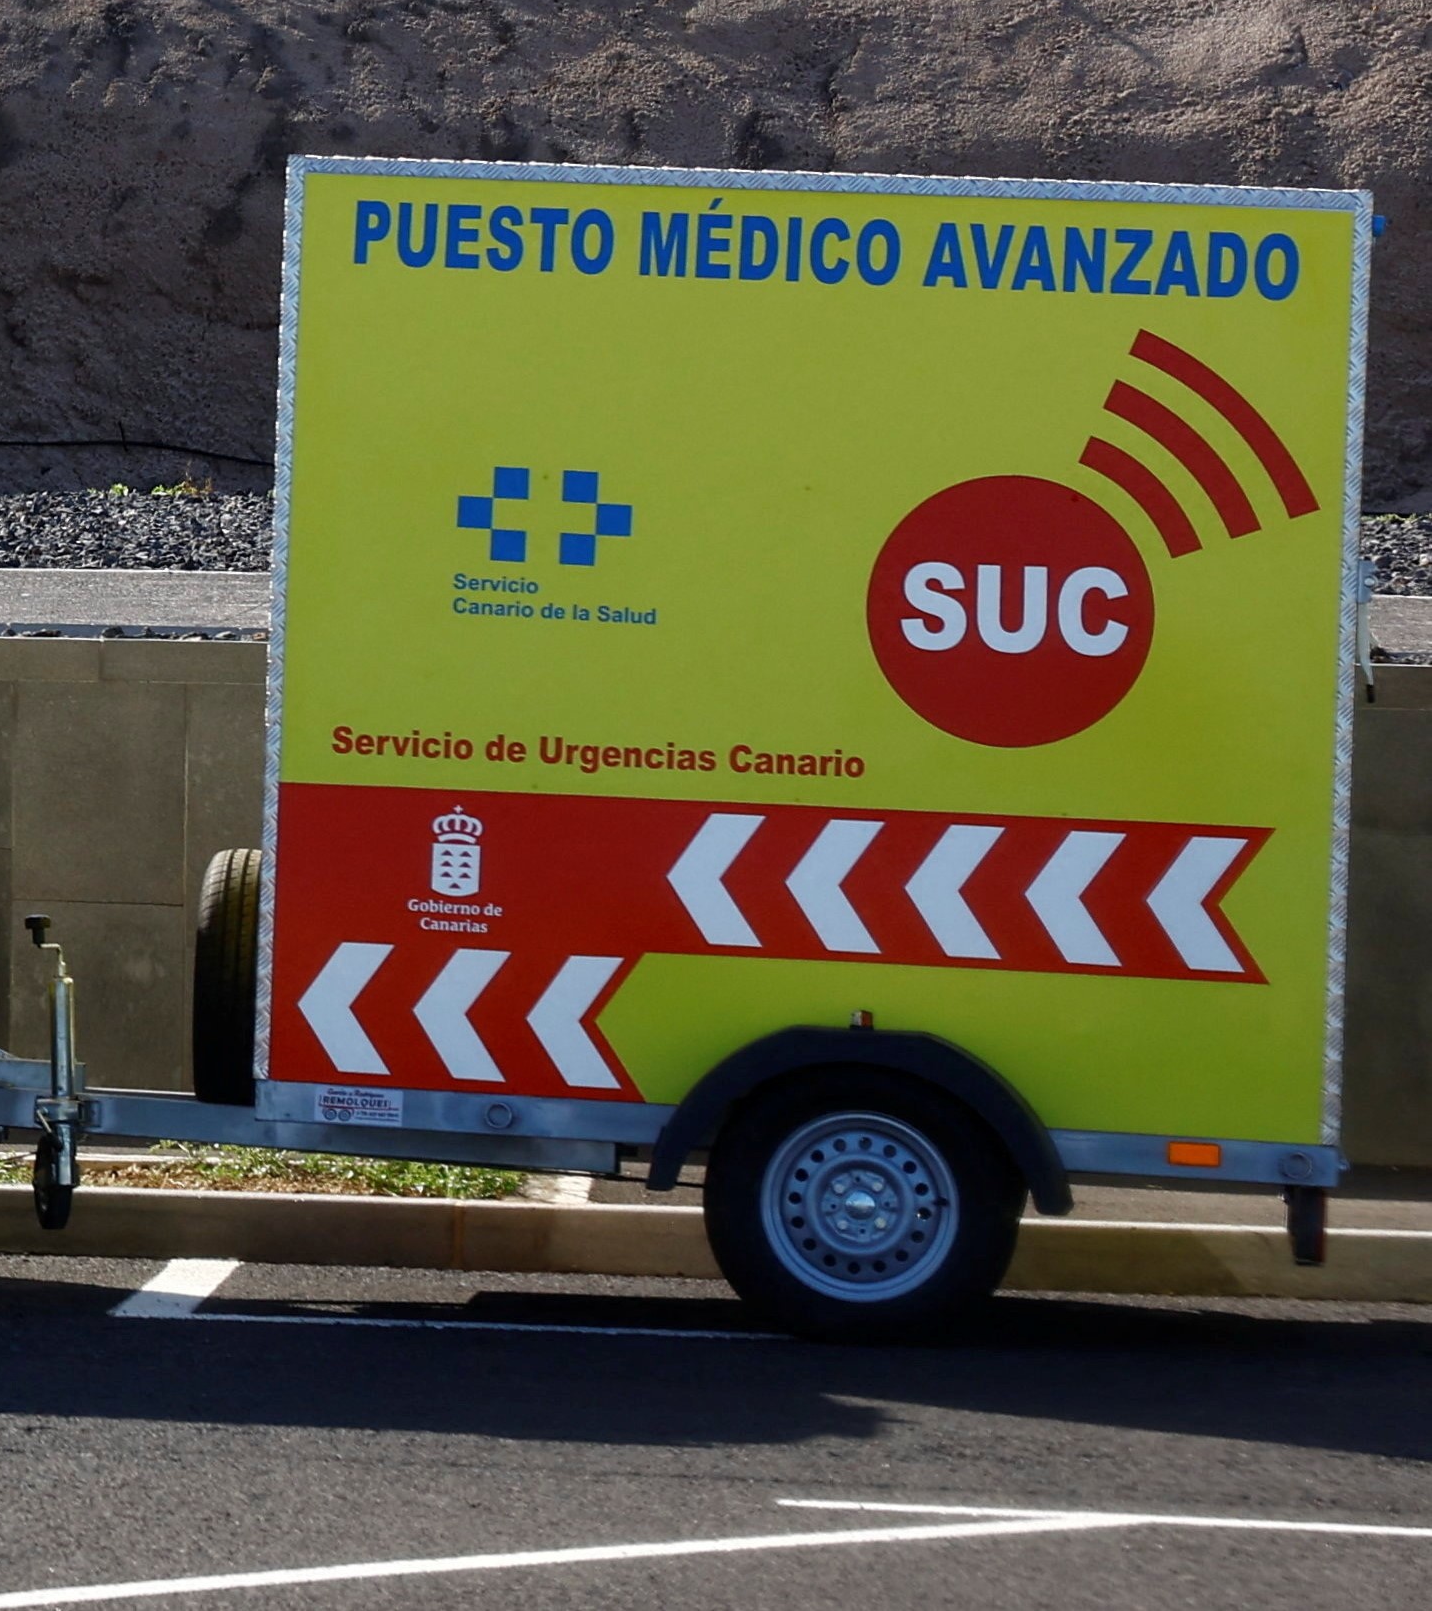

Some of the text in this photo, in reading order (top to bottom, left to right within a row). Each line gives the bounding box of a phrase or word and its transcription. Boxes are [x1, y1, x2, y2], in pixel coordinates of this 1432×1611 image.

[354, 198, 1299, 300] PUESTO MÉDICO AVANZADO
[452, 573, 540, 597] Servicio
[452, 596, 658, 625] Canario de la Salud
[899, 560, 1130, 659] SUC
[332, 726, 865, 777] Servicio de Urgencias Canario
[407, 899, 503, 916] Gobierno de
[420, 917, 488, 933] Canarias
